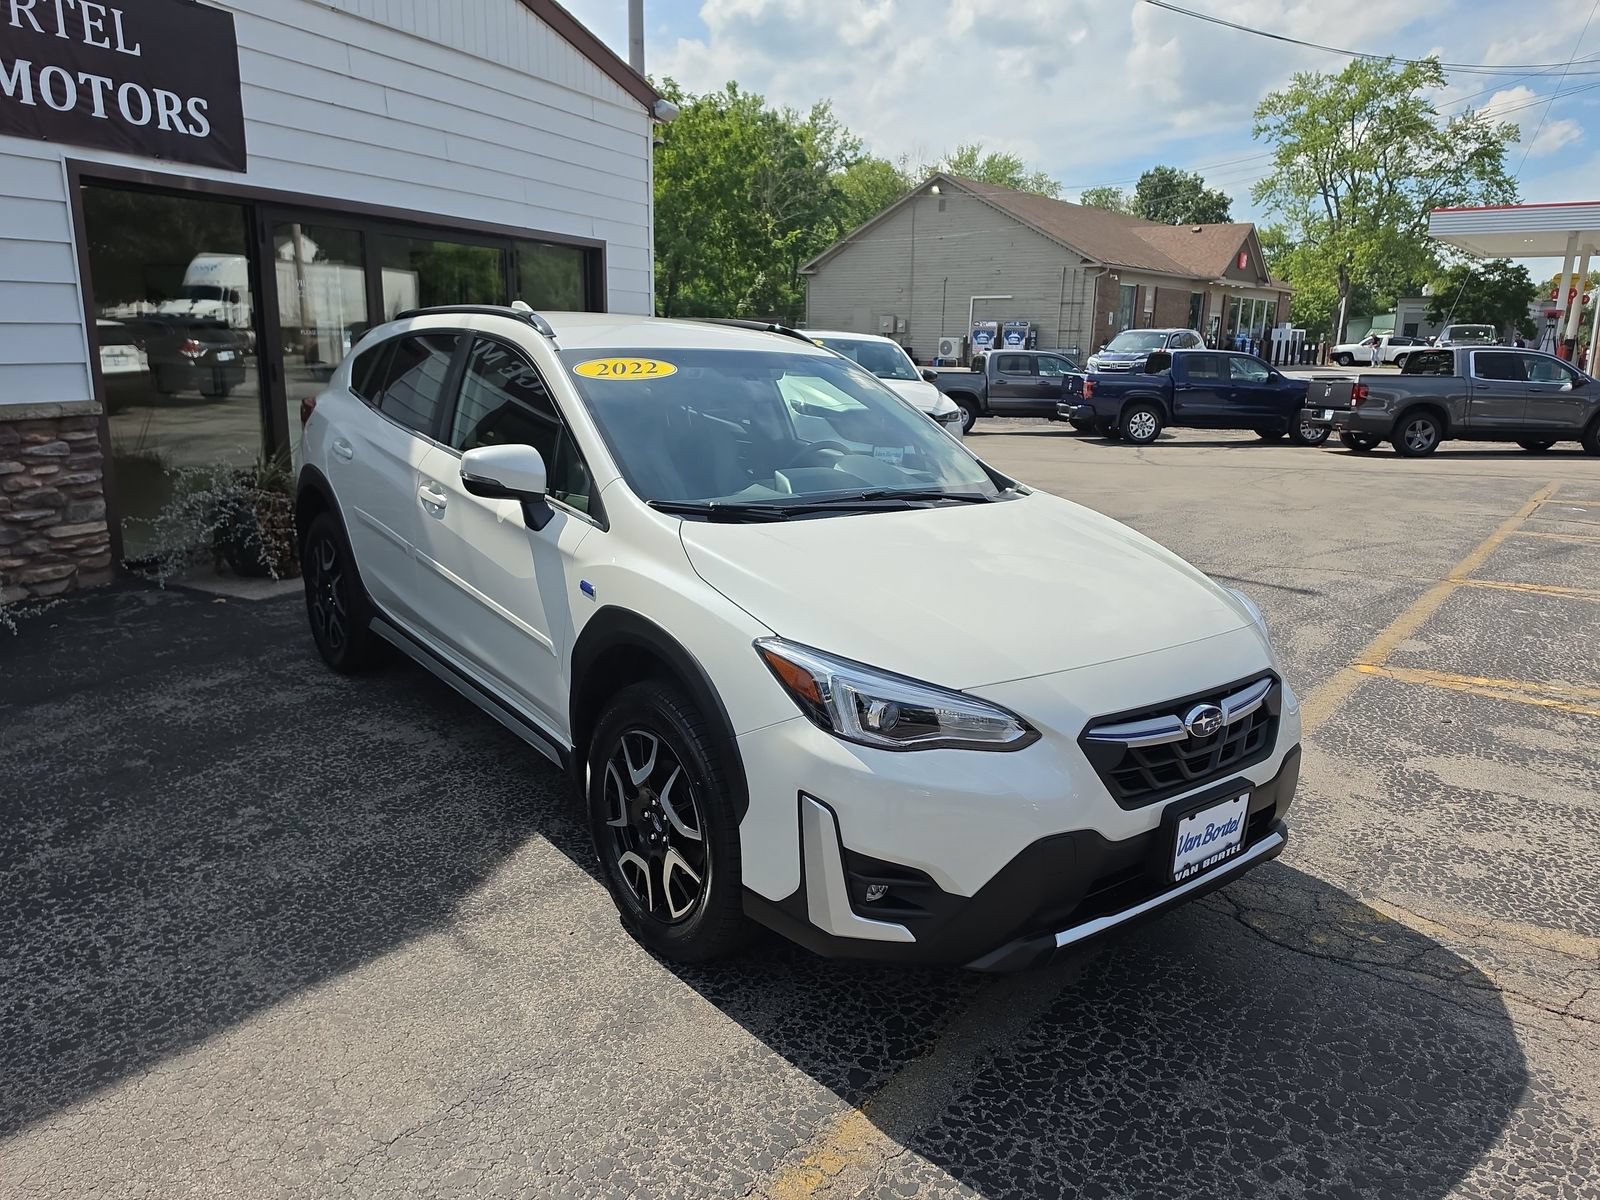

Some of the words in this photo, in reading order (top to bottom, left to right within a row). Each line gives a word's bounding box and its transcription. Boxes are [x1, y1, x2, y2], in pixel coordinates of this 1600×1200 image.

[0, 59, 211, 138] MOTORS
[596, 362, 658, 376] 2022
[1177, 832, 1202, 857] Van
[1201, 811, 1244, 846] Bortel
[1174, 863, 1199, 882] VAN
[1203, 843, 1241, 868] BORTEL
